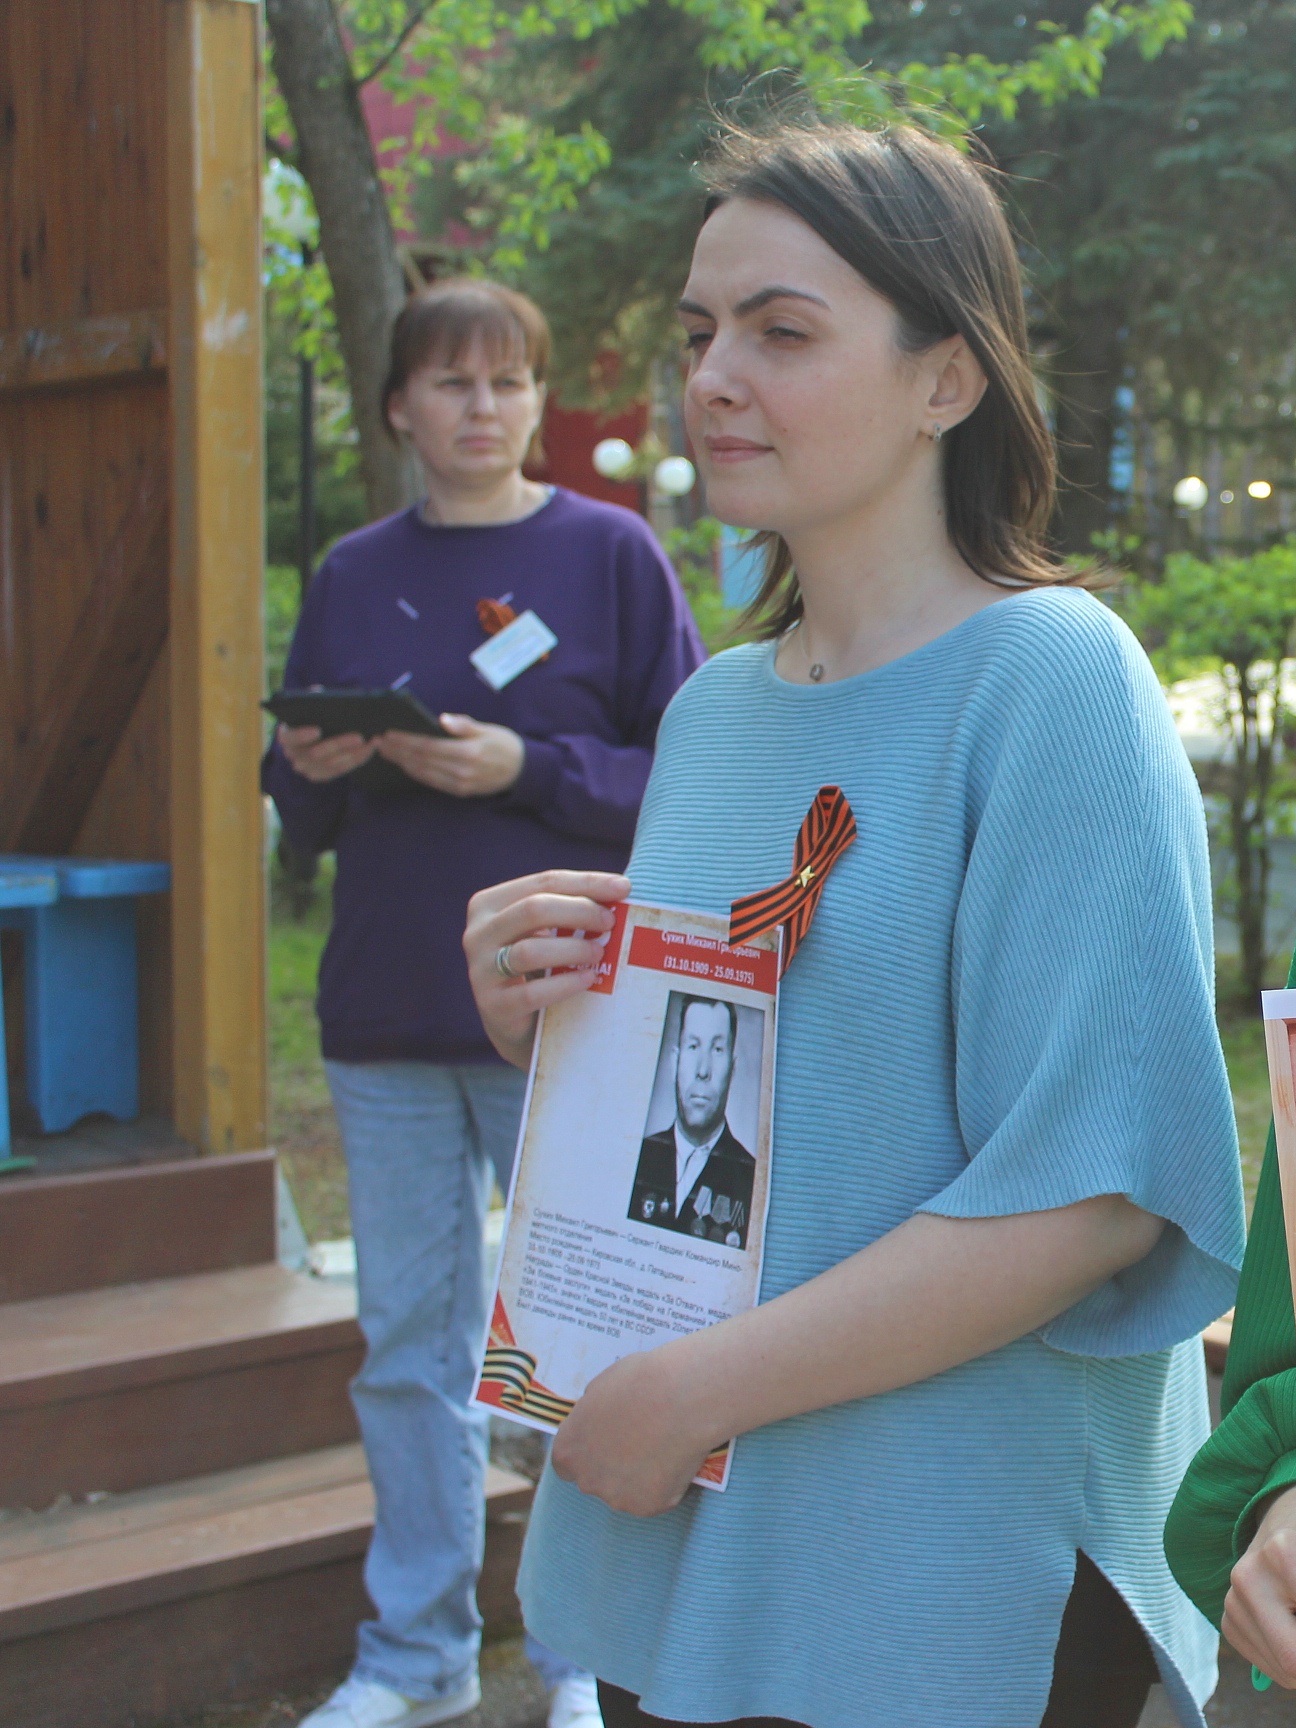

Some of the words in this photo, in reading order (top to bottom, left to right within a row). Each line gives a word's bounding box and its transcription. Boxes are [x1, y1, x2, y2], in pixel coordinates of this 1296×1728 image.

[661, 931, 685, 945] Сухих
[686, 933, 716, 949] Михаил
[664, 956, 708, 975] (31.10.1909
[714, 965, 755, 985] 25.09.1975)
[685, 1251, 721, 1267] Командир
